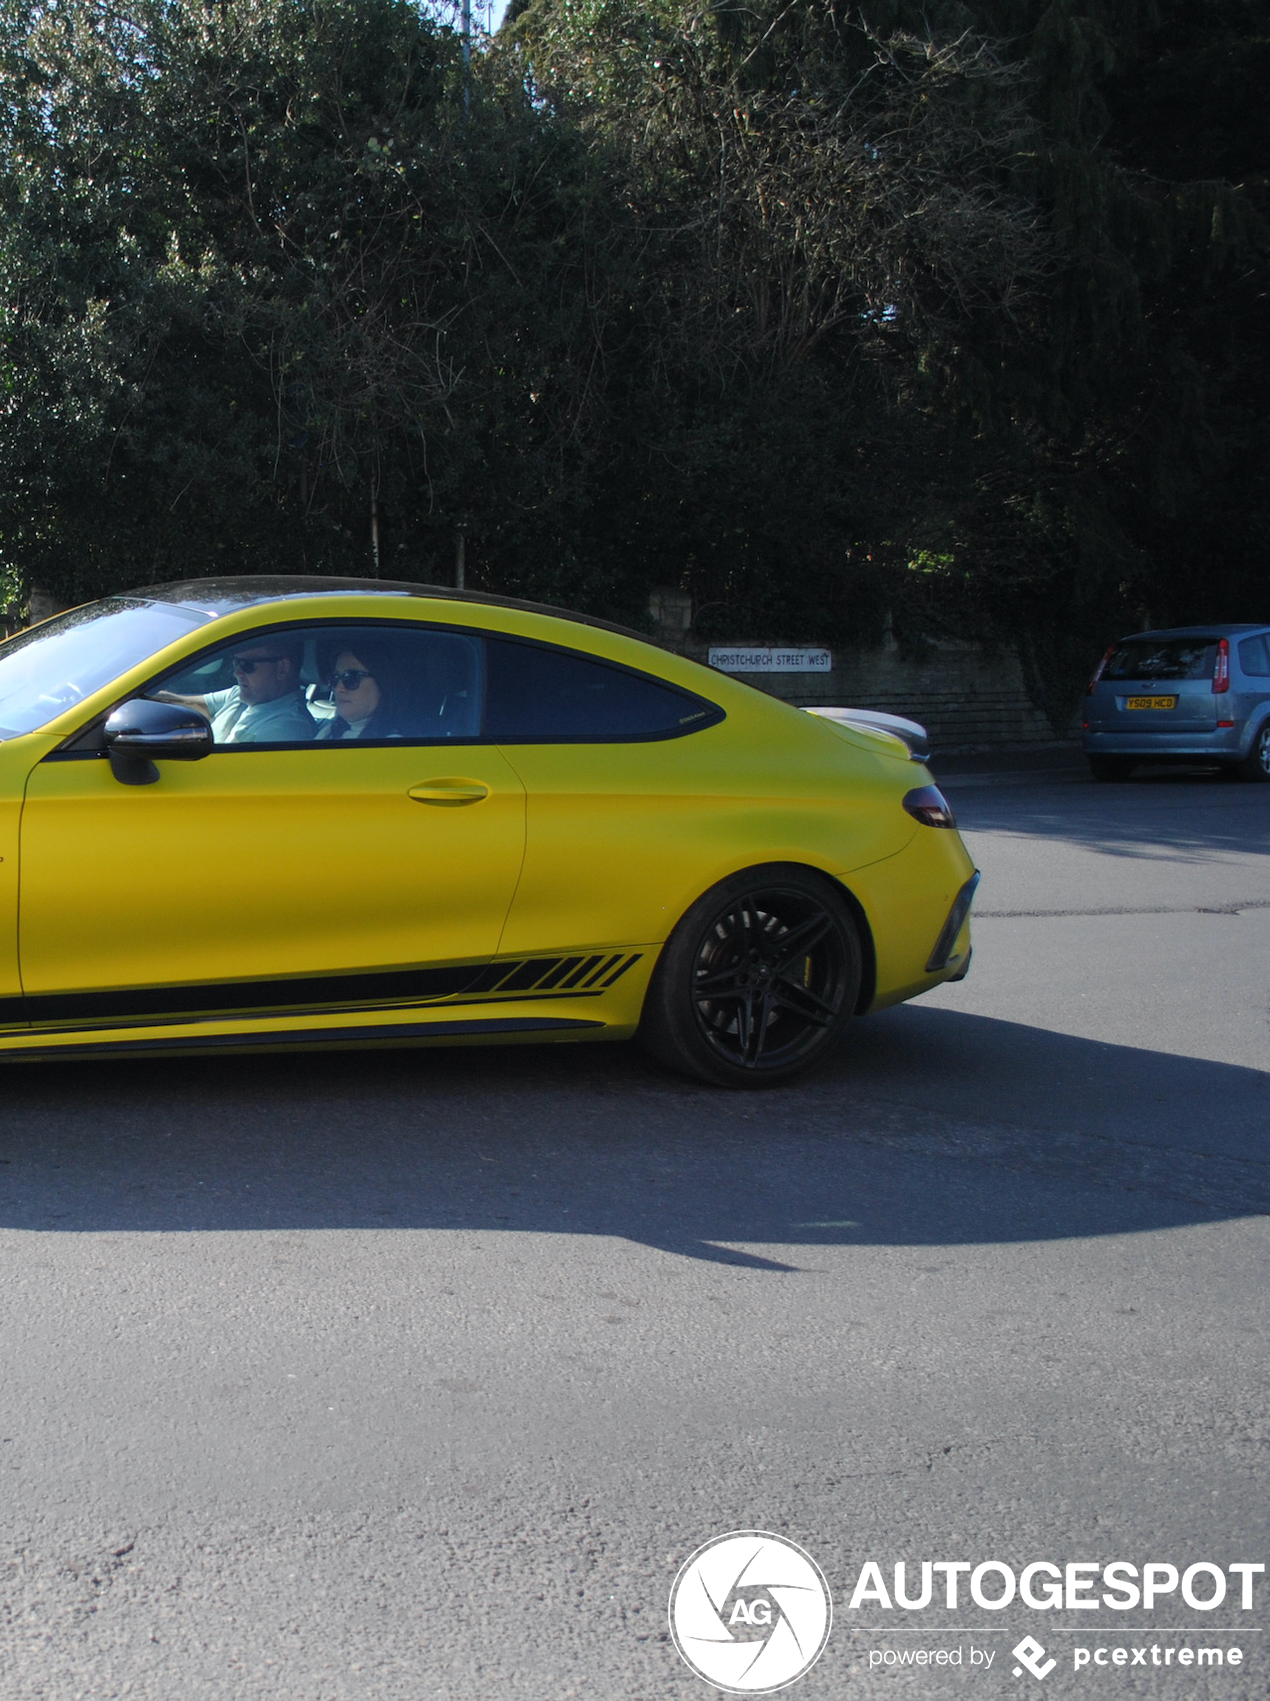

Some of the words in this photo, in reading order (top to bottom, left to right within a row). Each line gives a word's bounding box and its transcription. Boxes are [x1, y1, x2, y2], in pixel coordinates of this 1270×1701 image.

[711, 654, 772, 665] CHRISTCHURCH
[776, 655, 804, 665] STREET
[809, 655, 830, 665] WEST
